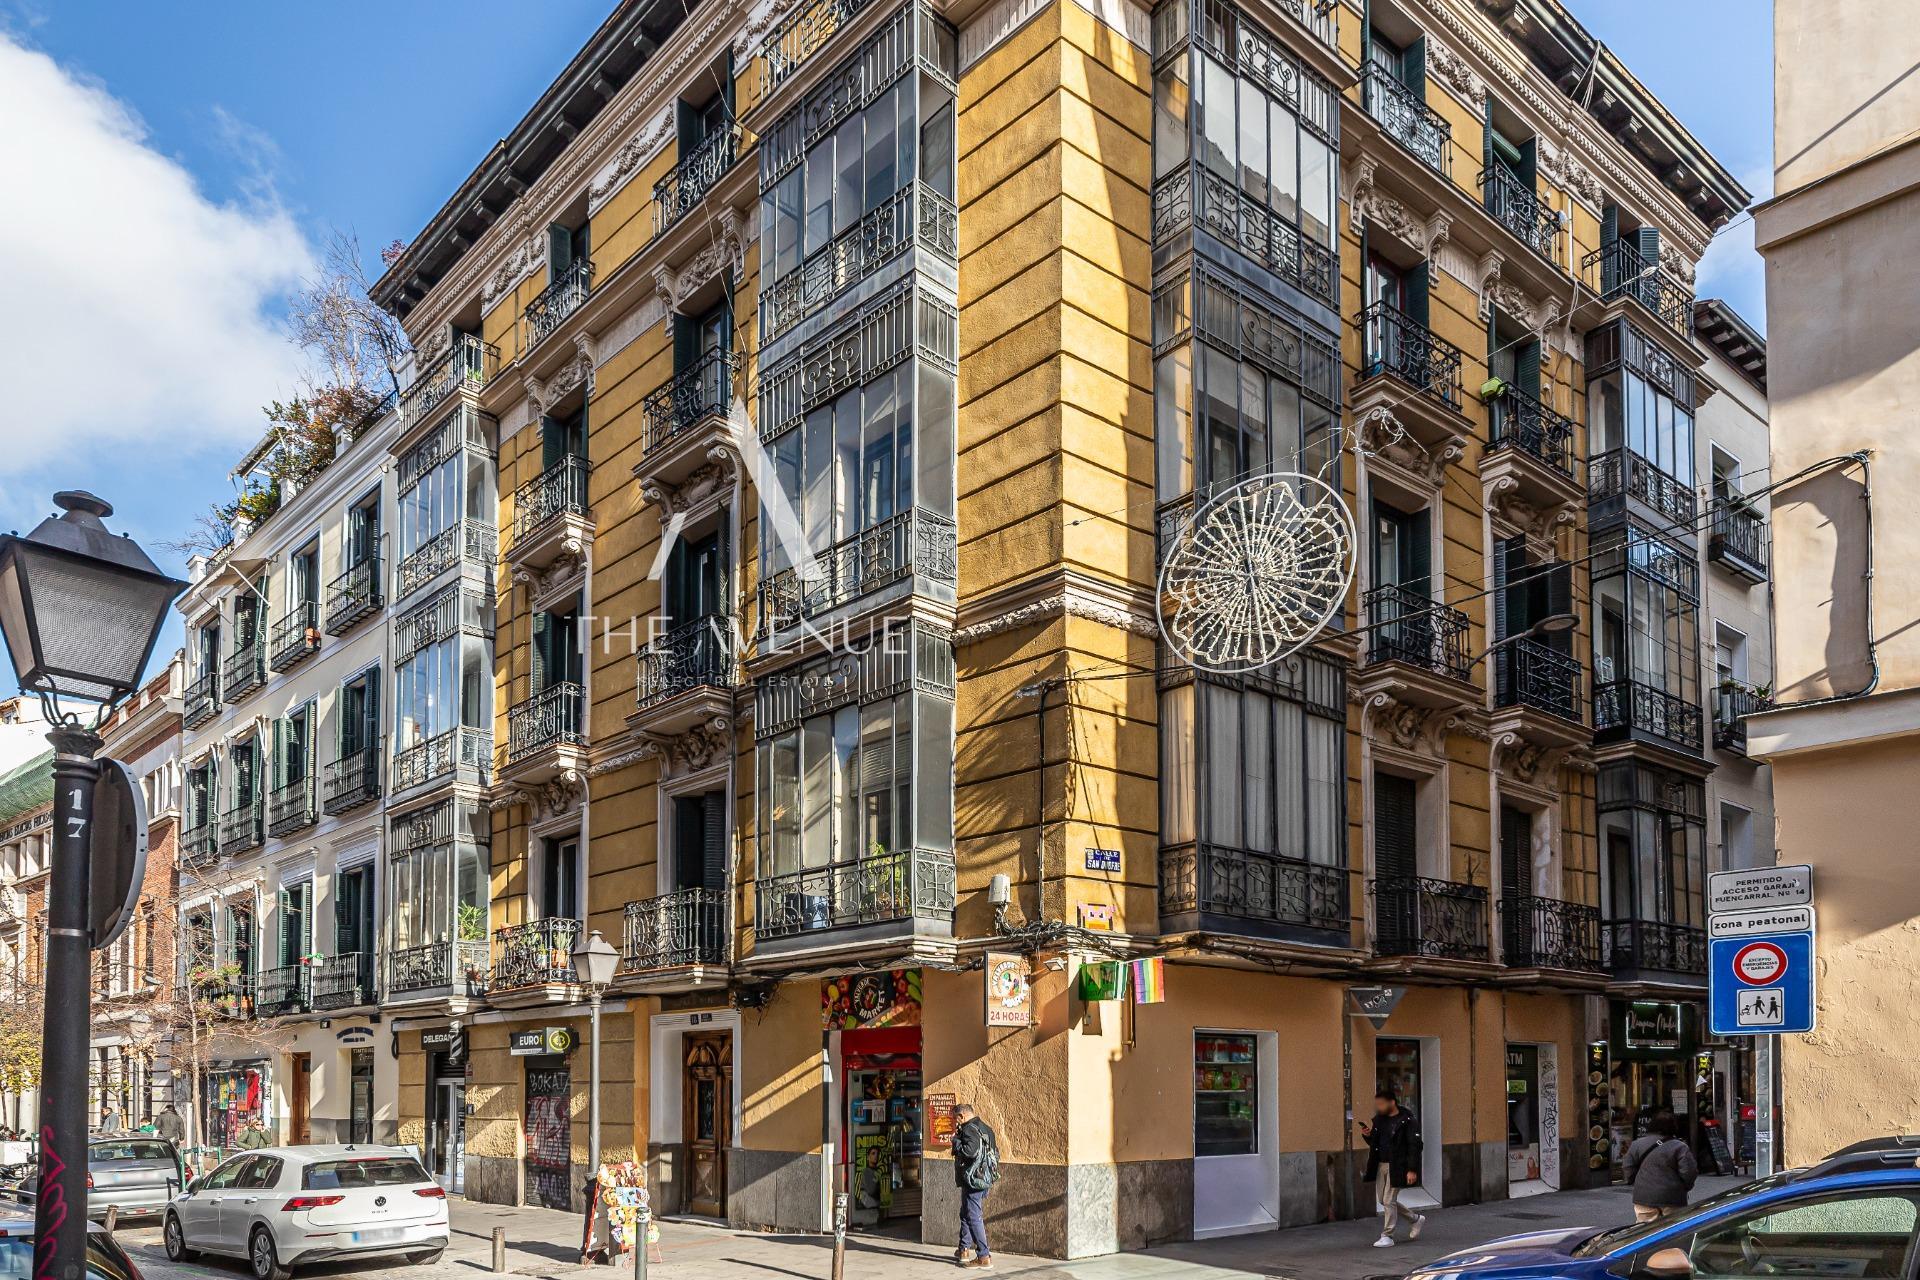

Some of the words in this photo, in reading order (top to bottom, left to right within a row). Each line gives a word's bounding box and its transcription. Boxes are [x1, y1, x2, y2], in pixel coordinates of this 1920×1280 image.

[1095, 850, 1119, 858] CALLE
[1087, 860, 1100, 869] SAN
[1735, 876, 1783, 886] PERMITIDO
[1722, 886, 1760, 895] ACCESO
[1714, 921, 1743, 929] zona
[1748, 914, 1806, 928] peatonal
[859, 990, 886, 1020] MARKET
[990, 1011, 1001, 1021] 24
[1003, 1011, 1030, 1022] HORAS
